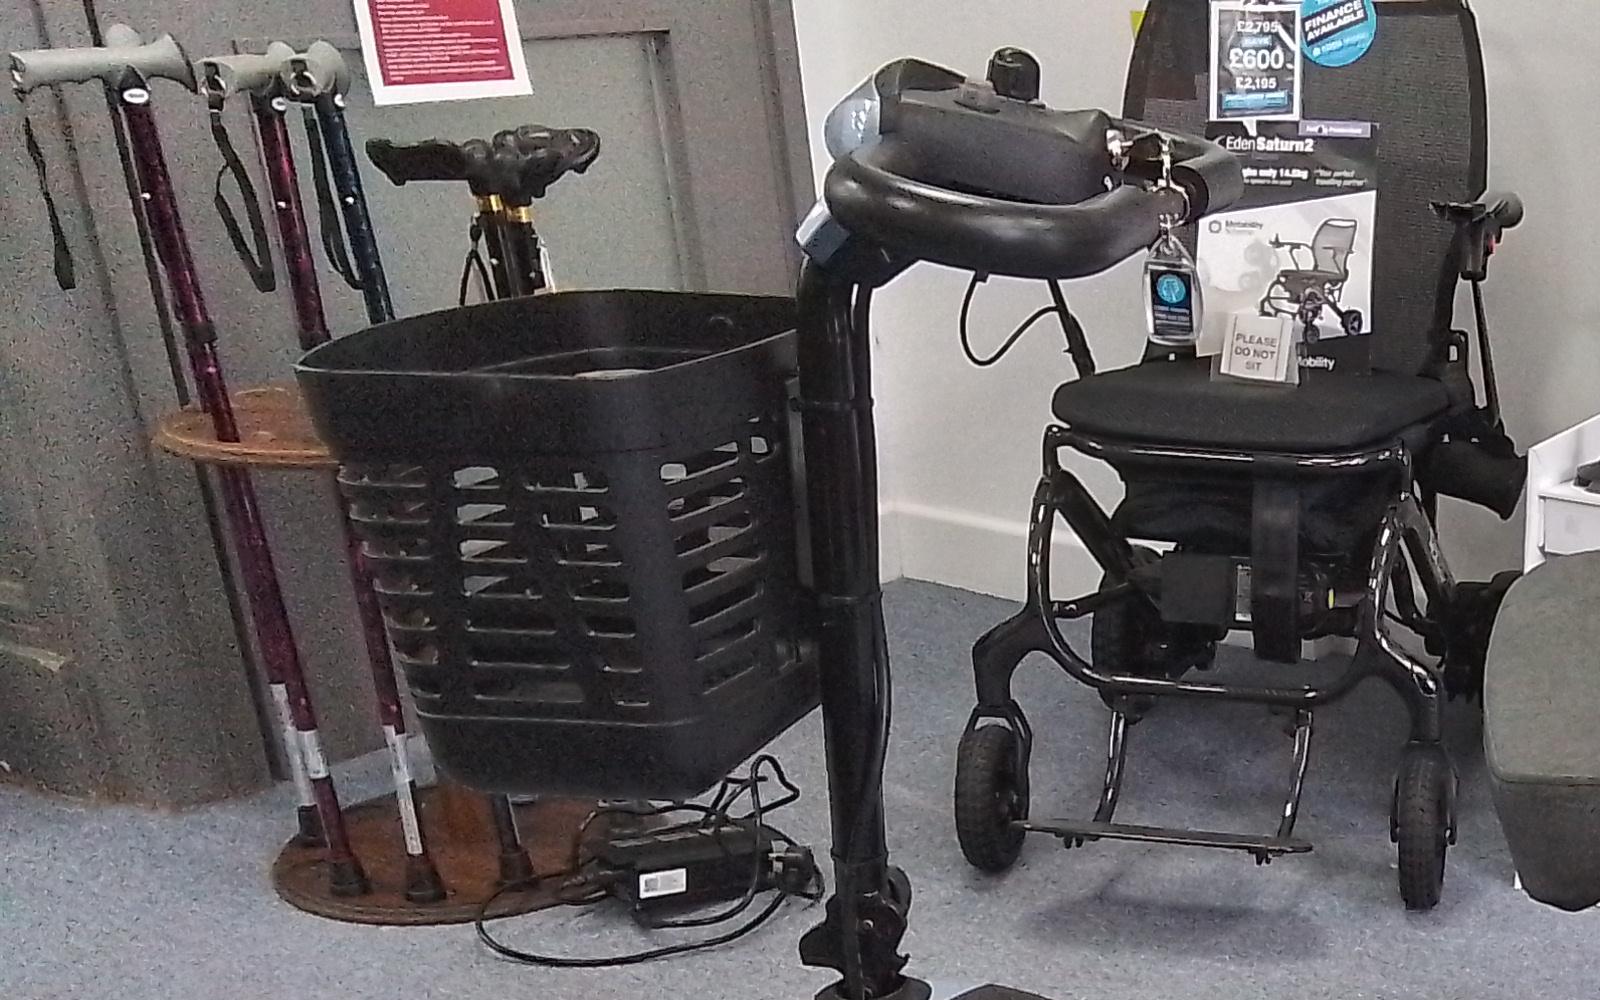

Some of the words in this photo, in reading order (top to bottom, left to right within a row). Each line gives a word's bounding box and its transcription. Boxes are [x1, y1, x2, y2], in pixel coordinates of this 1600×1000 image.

[1304, 0, 1362, 32] FINANCE
[1236, 21, 1279, 34] £2,795
[1307, 9, 1365, 41] AVAILABLE
[1229, 47, 1284, 70] £600
[1235, 76, 1277, 90] £2,195
[1236, 333, 1277, 347] PLEASE
[1234, 346, 1250, 356] DO
[1253, 349, 1276, 360] NOT
[1245, 361, 1262, 371] SIT
